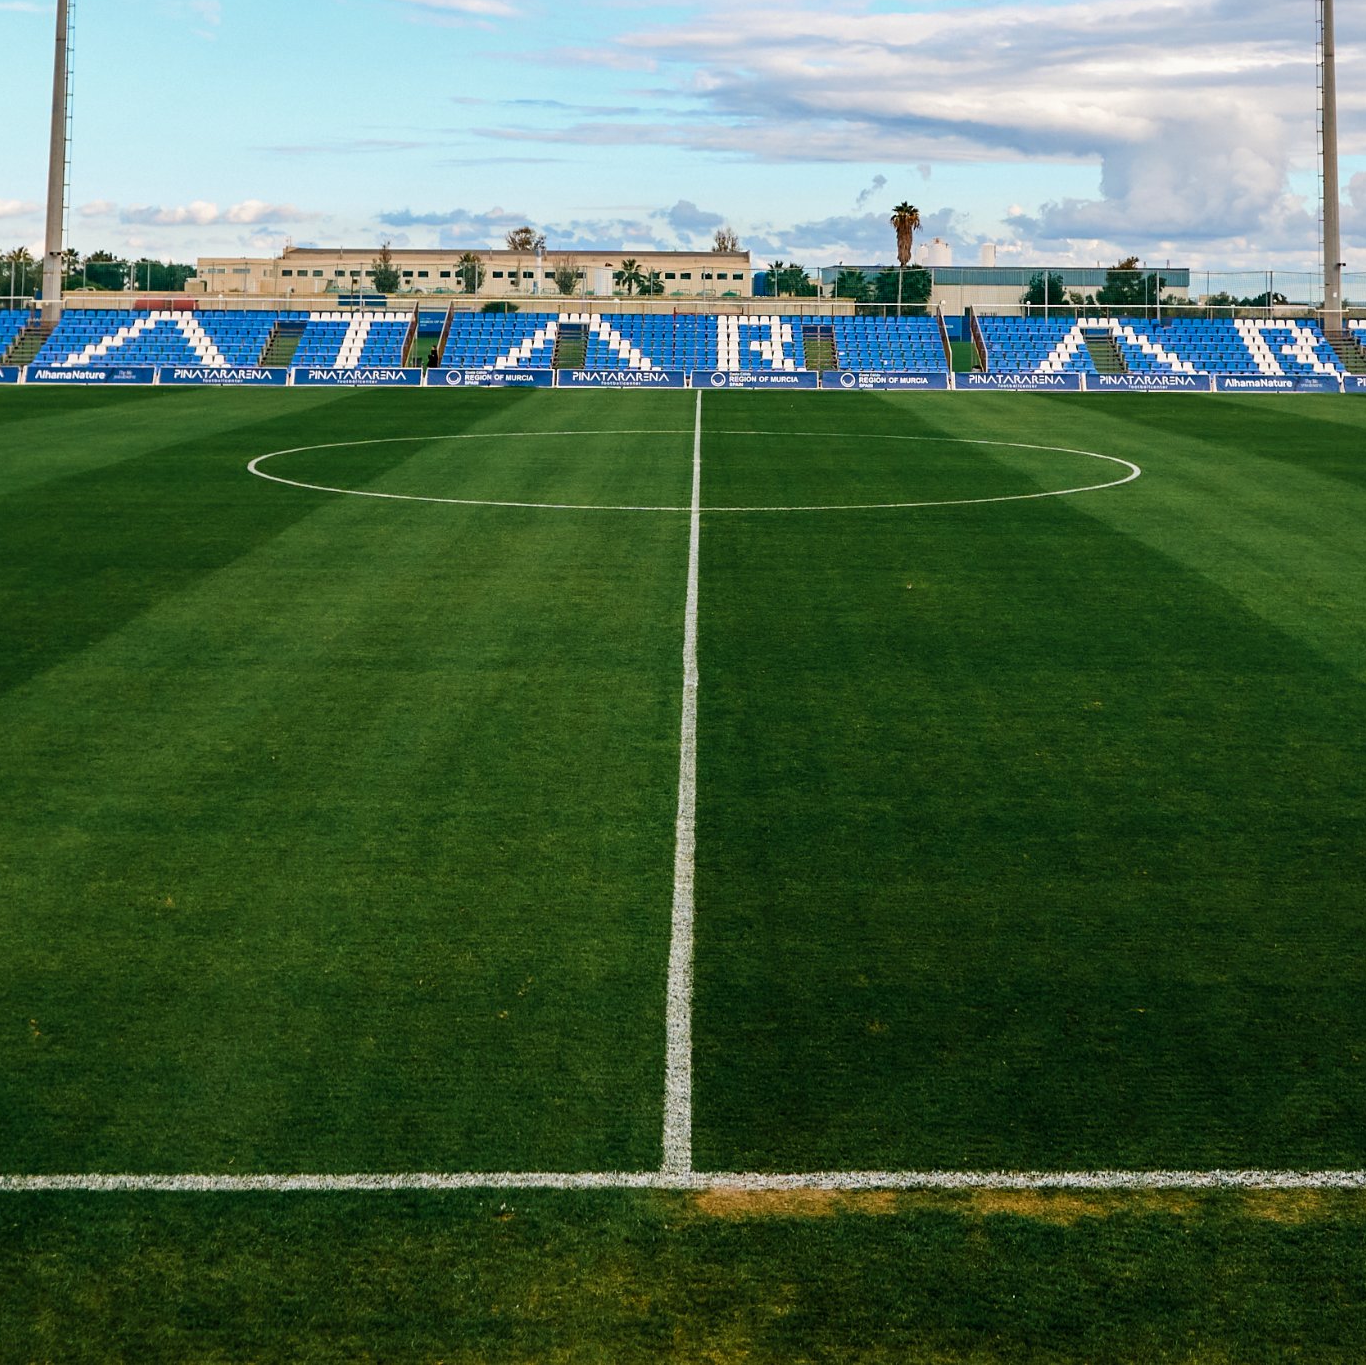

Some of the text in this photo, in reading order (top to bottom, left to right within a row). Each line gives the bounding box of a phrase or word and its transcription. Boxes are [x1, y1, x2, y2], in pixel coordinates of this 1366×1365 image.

[35, 369, 106, 380] AlhamaNature
[174, 368, 272, 379] PINATARARENA
[309, 369, 407, 380] PINATARARENA
[506, 374, 534, 382] MURCIA
[572, 371, 670, 383] PINATARARENA
[729, 375, 799, 383] REGION OF MURCIA
[859, 376, 929, 385] REGION OF MURCIA
[969, 374, 1066, 385] PINATARARENA
[1100, 375, 1196, 386] PINATARARENA
[1225, 378, 1293, 388] AlhamaNature
